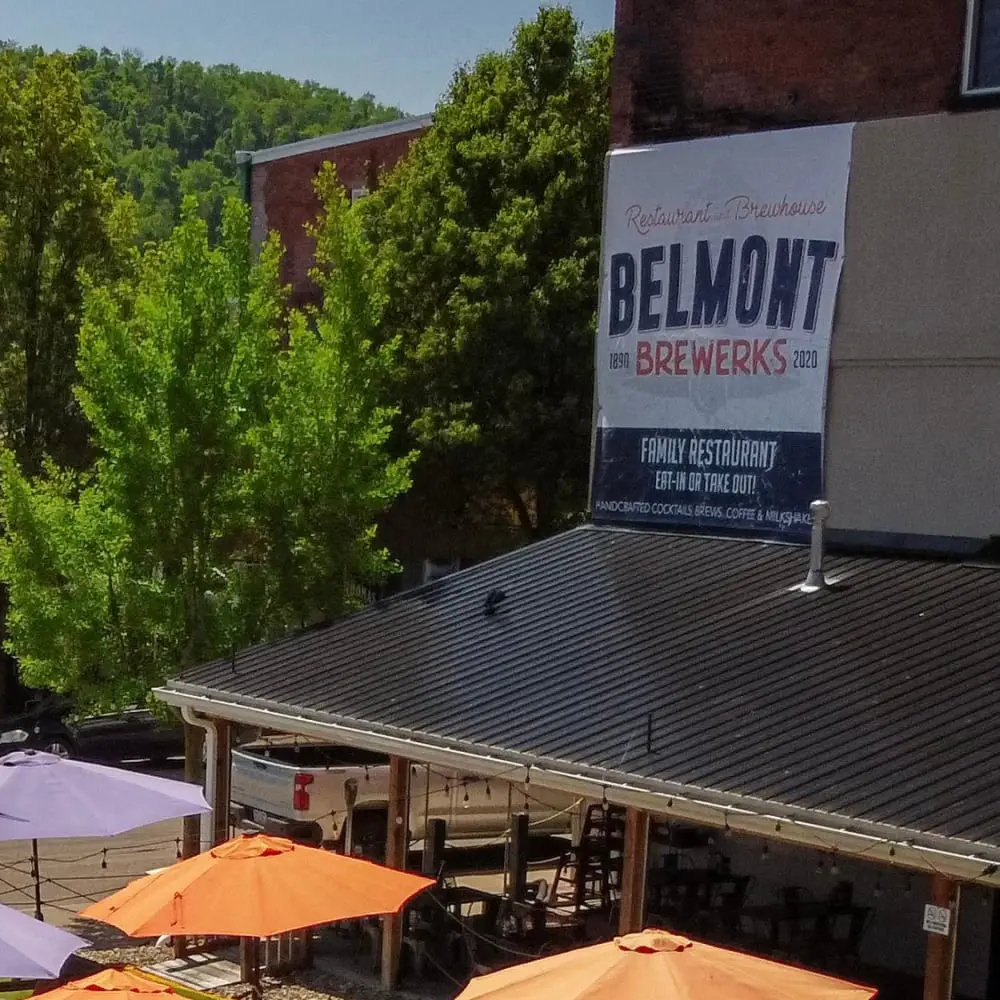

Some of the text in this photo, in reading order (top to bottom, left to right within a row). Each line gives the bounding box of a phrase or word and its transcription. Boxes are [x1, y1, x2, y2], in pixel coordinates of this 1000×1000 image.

[625, 194, 828, 235] Restaurant Brewhouse
[608, 234, 839, 338] BELMONT
[636, 338, 788, 376] BREWERKS
[793, 350, 818, 369] 2020
[640, 437, 778, 472] FAMILY RESTAURANT
[655, 471, 757, 496] EAT-IN OR TAKE OUT!
[595, 500, 650, 514] HANDCRAFTED
[726, 507, 757, 520] COFFEE
[757, 508, 763, 520] &
[765, 509, 813, 525] MILKSHAKE
